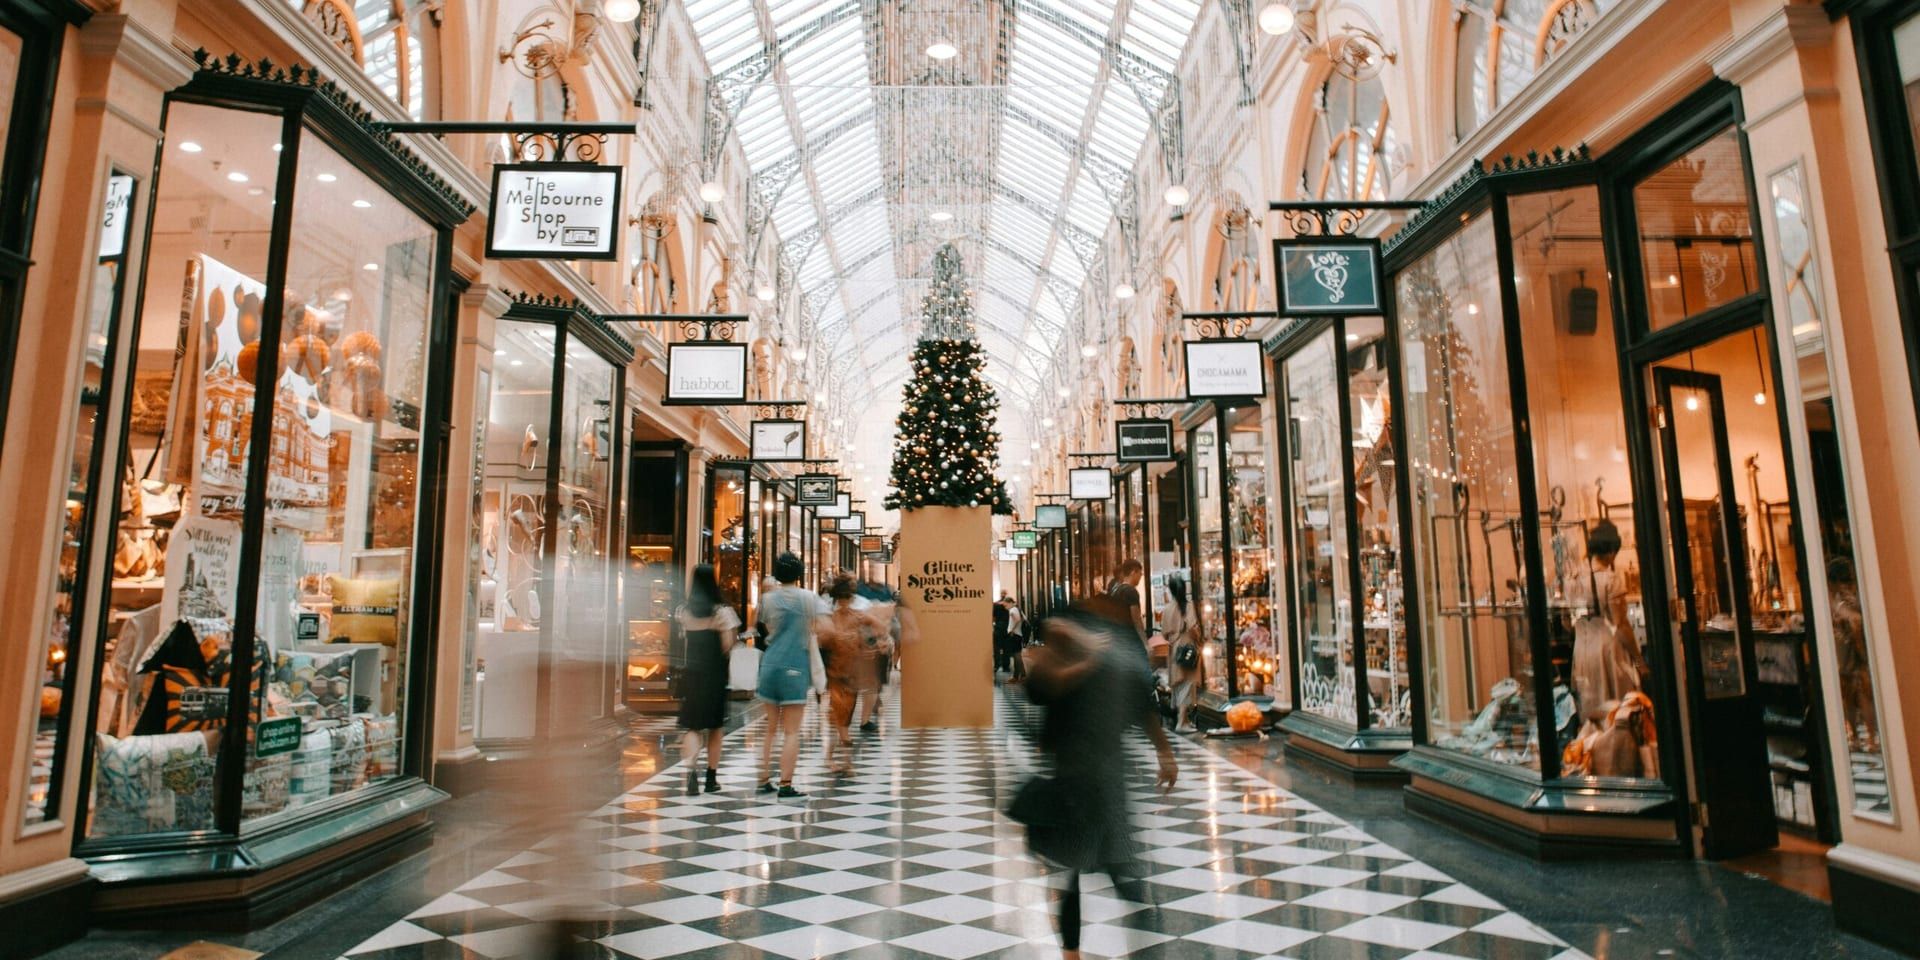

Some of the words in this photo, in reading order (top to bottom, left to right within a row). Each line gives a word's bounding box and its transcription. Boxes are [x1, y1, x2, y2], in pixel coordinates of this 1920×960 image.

[526, 177, 556, 191] The
[506, 189, 603, 206] Melbourne
[520, 207, 566, 227] Shop
[537, 226, 558, 243] by
[680, 376, 733, 391] habbot.
[923, 560, 975, 576] Glitter.
[907, 573, 964, 589] Sparkle
